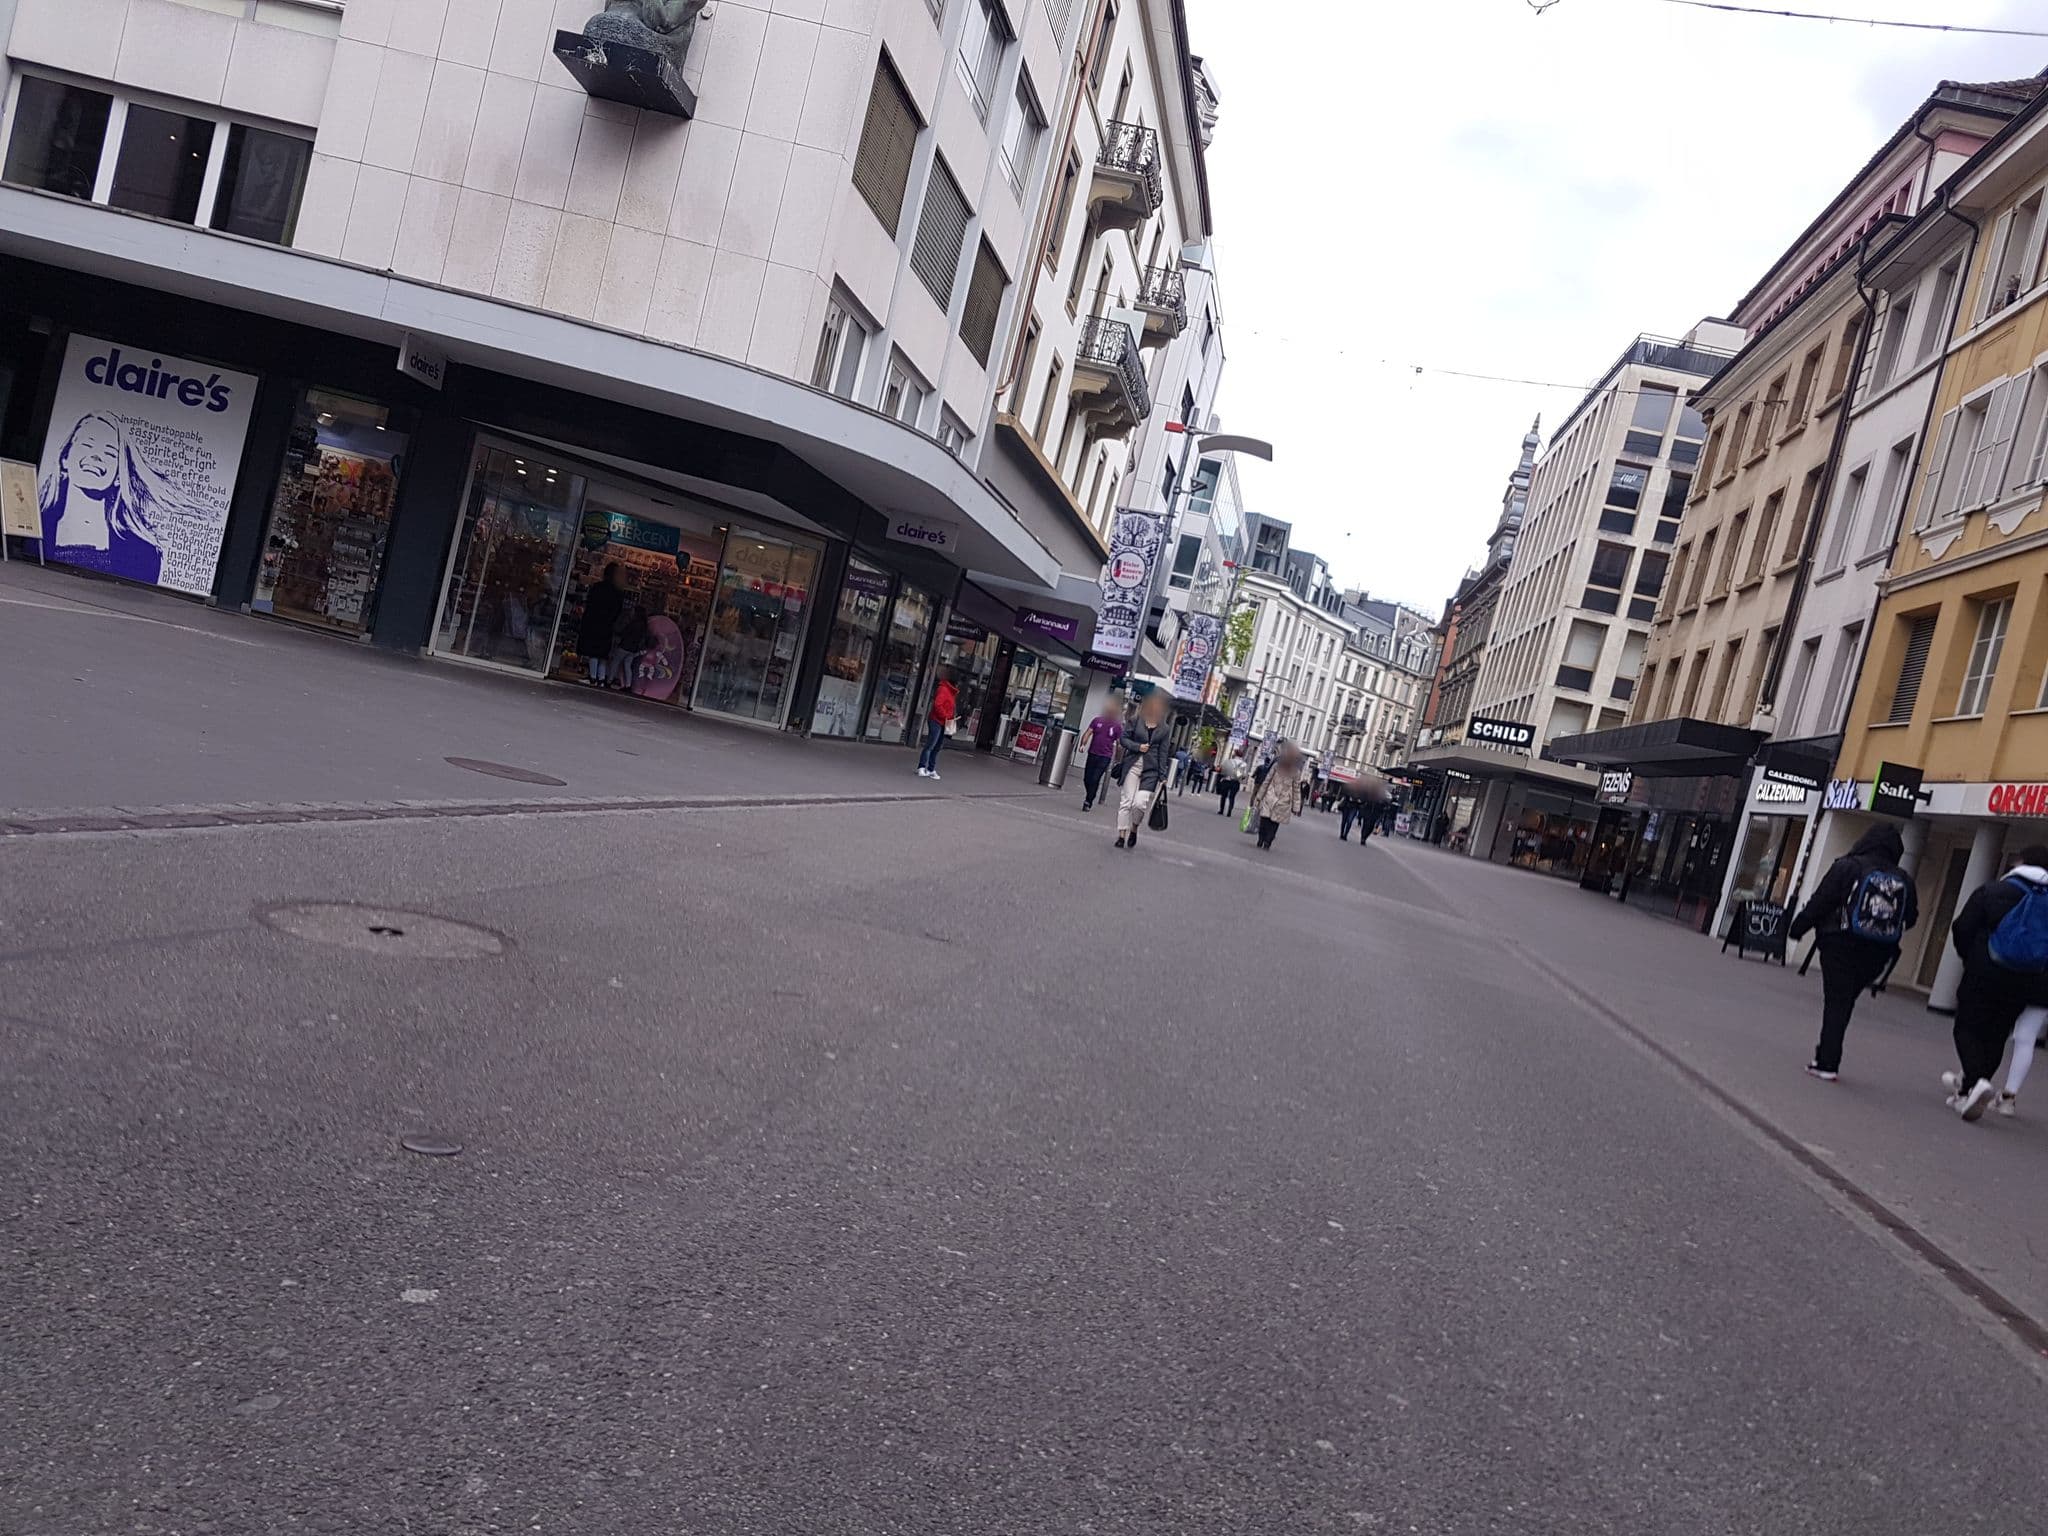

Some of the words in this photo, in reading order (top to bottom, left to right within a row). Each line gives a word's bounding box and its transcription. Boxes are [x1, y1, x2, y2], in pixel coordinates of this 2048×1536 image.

[410, 351, 440, 380] claire's
[85, 347, 232, 413] claire's
[120, 414, 150, 428] inspire
[150, 423, 204, 444] unstoppable
[128, 426, 161, 444] sassy
[160, 436, 195, 453] carefree
[195, 447, 213, 460] fun
[142, 444, 186, 460] spirited
[183, 454, 217, 473] bright
[150, 457, 184, 472] creative
[164, 467, 211, 483] carefree
[187, 487, 210, 500] shine
[208, 496, 230, 511] real
[207, 483, 227, 496] bold
[168, 511, 224, 536] independent
[896, 522, 947, 545] claire's
[167, 531, 219, 553] enchanting
[171, 540, 192, 552] bold
[167, 547, 201, 563] inspire
[167, 559, 212, 577] confident
[1023, 612, 1070, 631] Marionnaud
[1472, 721, 1529, 742] SCHILD
[1447, 769, 1471, 780] SCHILD
[1600, 766, 1632, 793] TEZENIS
[1768, 769, 1818, 787] CALZEDONIA
[1755, 783, 1806, 802] CALZEDONIA
[1822, 777, 1858, 809] Salt.
[1879, 781, 1915, 801] Salt.
